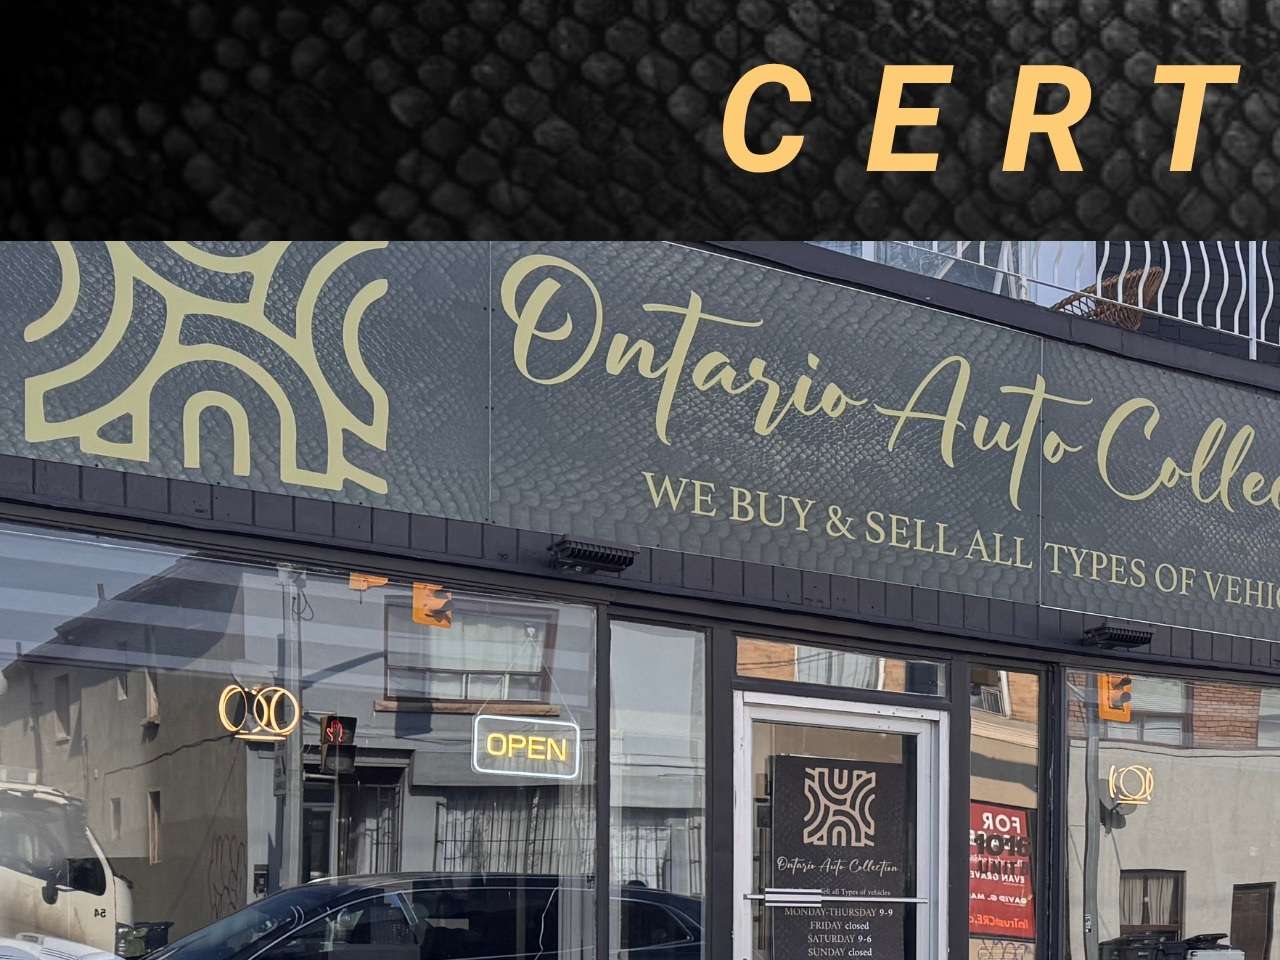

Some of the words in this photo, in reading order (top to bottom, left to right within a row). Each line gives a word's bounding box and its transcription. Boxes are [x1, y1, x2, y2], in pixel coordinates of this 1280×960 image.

[500, 254, 868, 446] Ontario
[874, 355, 1094, 511] Auto
[642, 471, 717, 517] WE
[729, 486, 816, 532] BUY
[825, 505, 856, 540] &
[866, 511, 957, 556] SELL
[965, 529, 1033, 569] ALL
[1043, 542, 1146, 588] TYPES
[1155, 563, 1196, 596] OF
[487, 733, 566, 761] OPEN
[776, 856, 816, 876] Ontario
[816, 858, 848, 878] Auto
[849, 858, 899, 878] Collection
[784, 907, 877, 917] MONDAY-THURSDAY
[879, 908, 893, 917] 9-9
[810, 921, 842, 930] FRIDAY
[845, 921, 870, 930] closed
[807, 934, 855, 943] SATURDAY
[858, 934, 872, 943] 9-6
[807, 947, 846, 956] SUNDAY
[848, 948, 872, 956] closed
